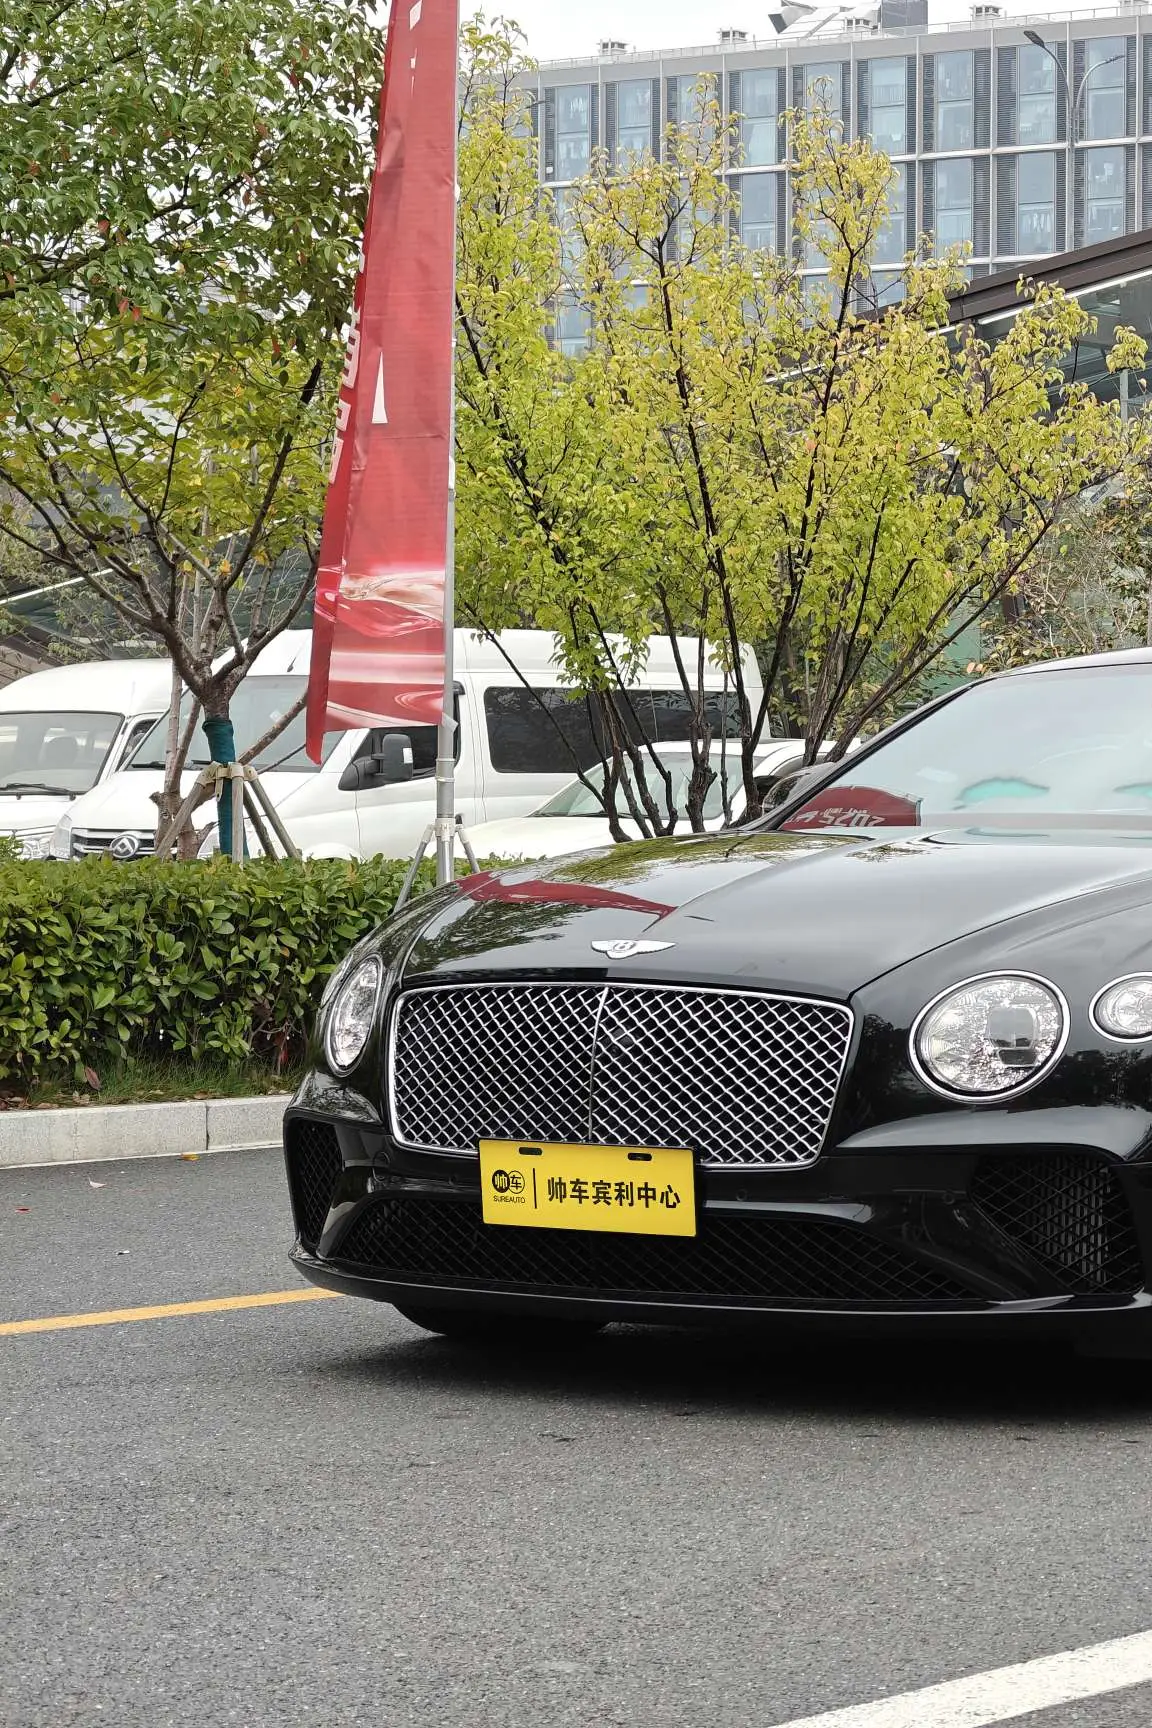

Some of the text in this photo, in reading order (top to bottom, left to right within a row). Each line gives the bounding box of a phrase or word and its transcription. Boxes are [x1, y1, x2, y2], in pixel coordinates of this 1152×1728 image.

[493, 1172, 523, 1191] 帅车
[493, 1195, 526, 1204] SUREAUTO
[547, 1176, 681, 1208] 帅车宾利中心
